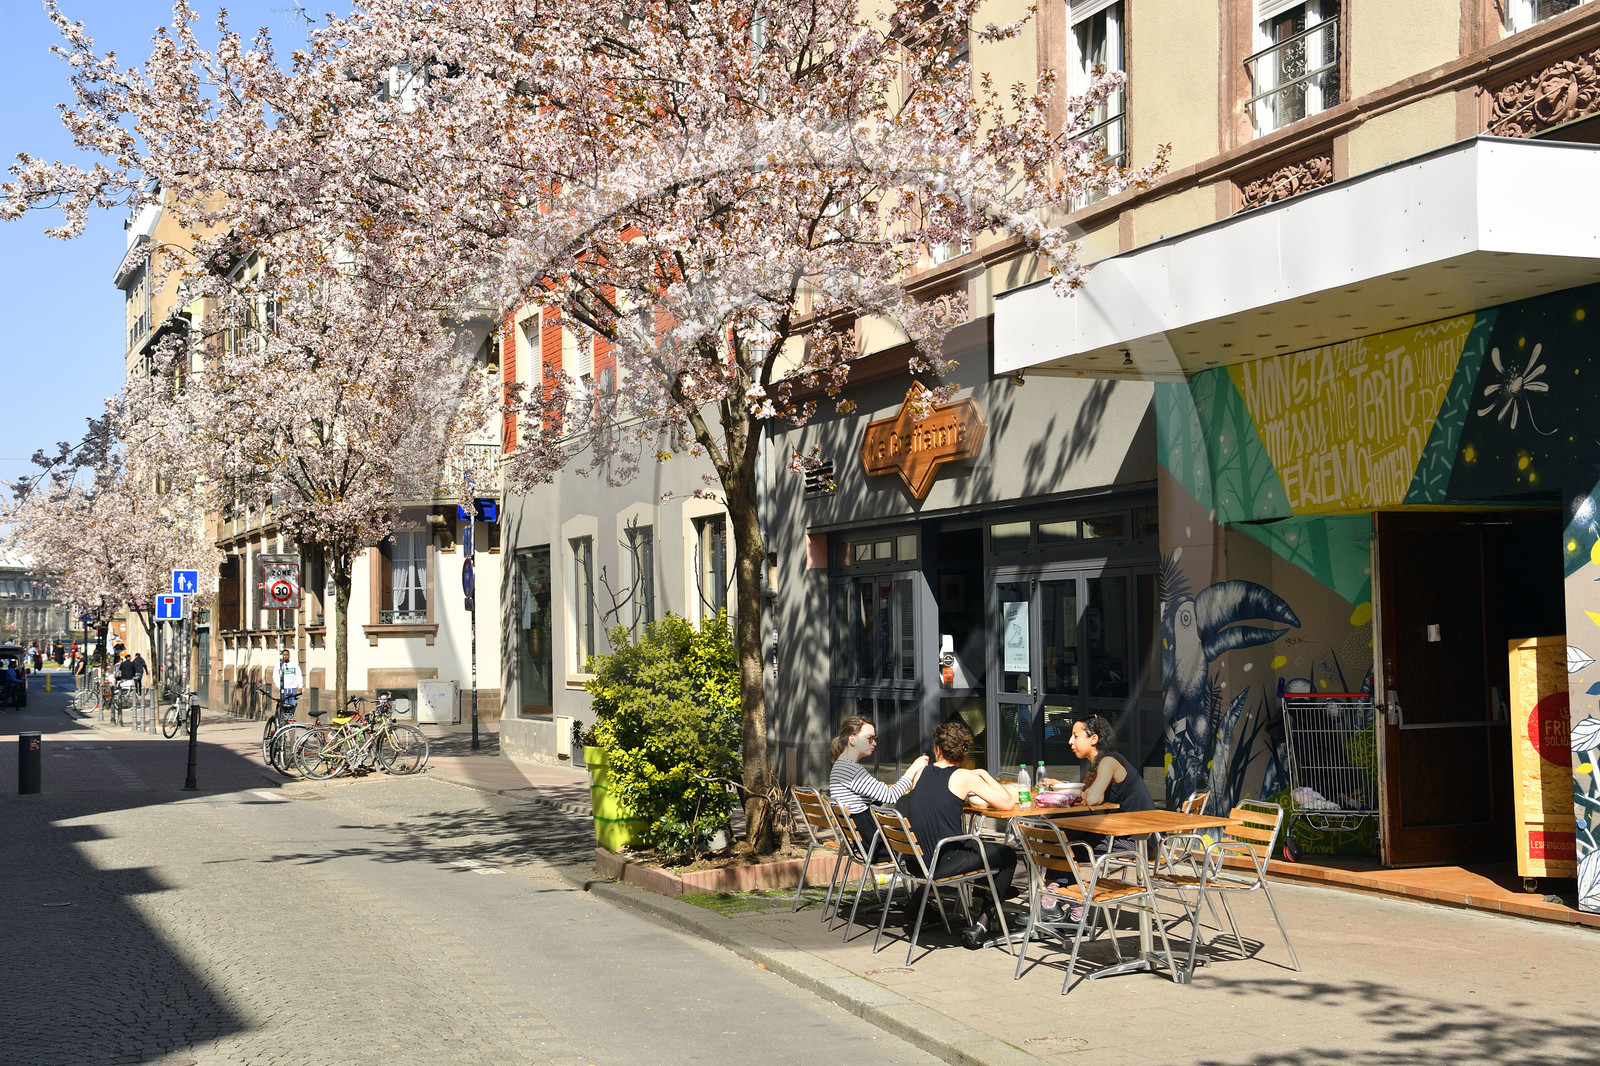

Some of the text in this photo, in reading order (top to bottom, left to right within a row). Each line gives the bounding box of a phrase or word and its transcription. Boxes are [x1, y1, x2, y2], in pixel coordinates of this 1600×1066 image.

[1243, 346, 1335, 424] MONSTA
[1264, 402, 1329, 468] missy
[275, 586, 288, 596] 30
[1544, 736, 1571, 747] SOLID
